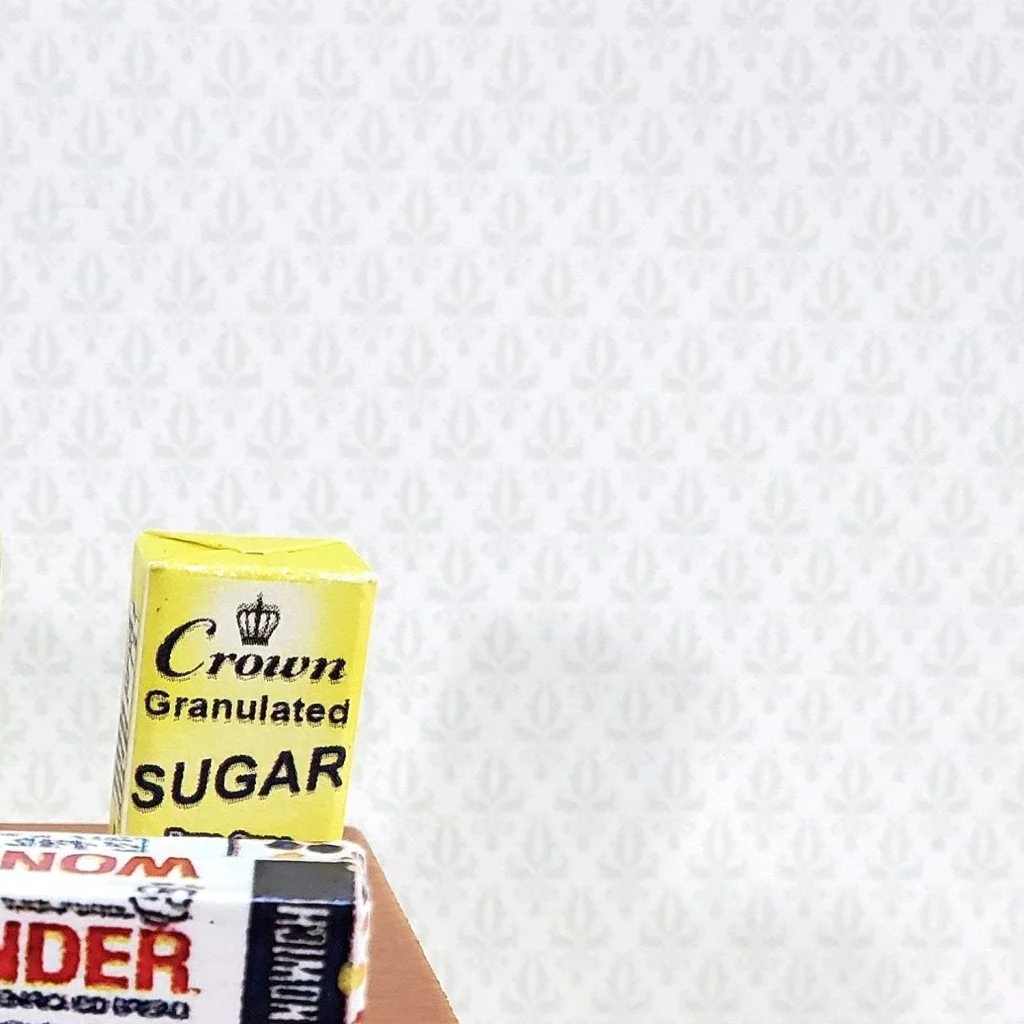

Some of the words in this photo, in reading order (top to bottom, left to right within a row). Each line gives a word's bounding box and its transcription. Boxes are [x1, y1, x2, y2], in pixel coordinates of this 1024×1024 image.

[155, 618, 347, 682] Crown
[145, 690, 350, 728] Granulated
[131, 745, 346, 813] SUGAR
